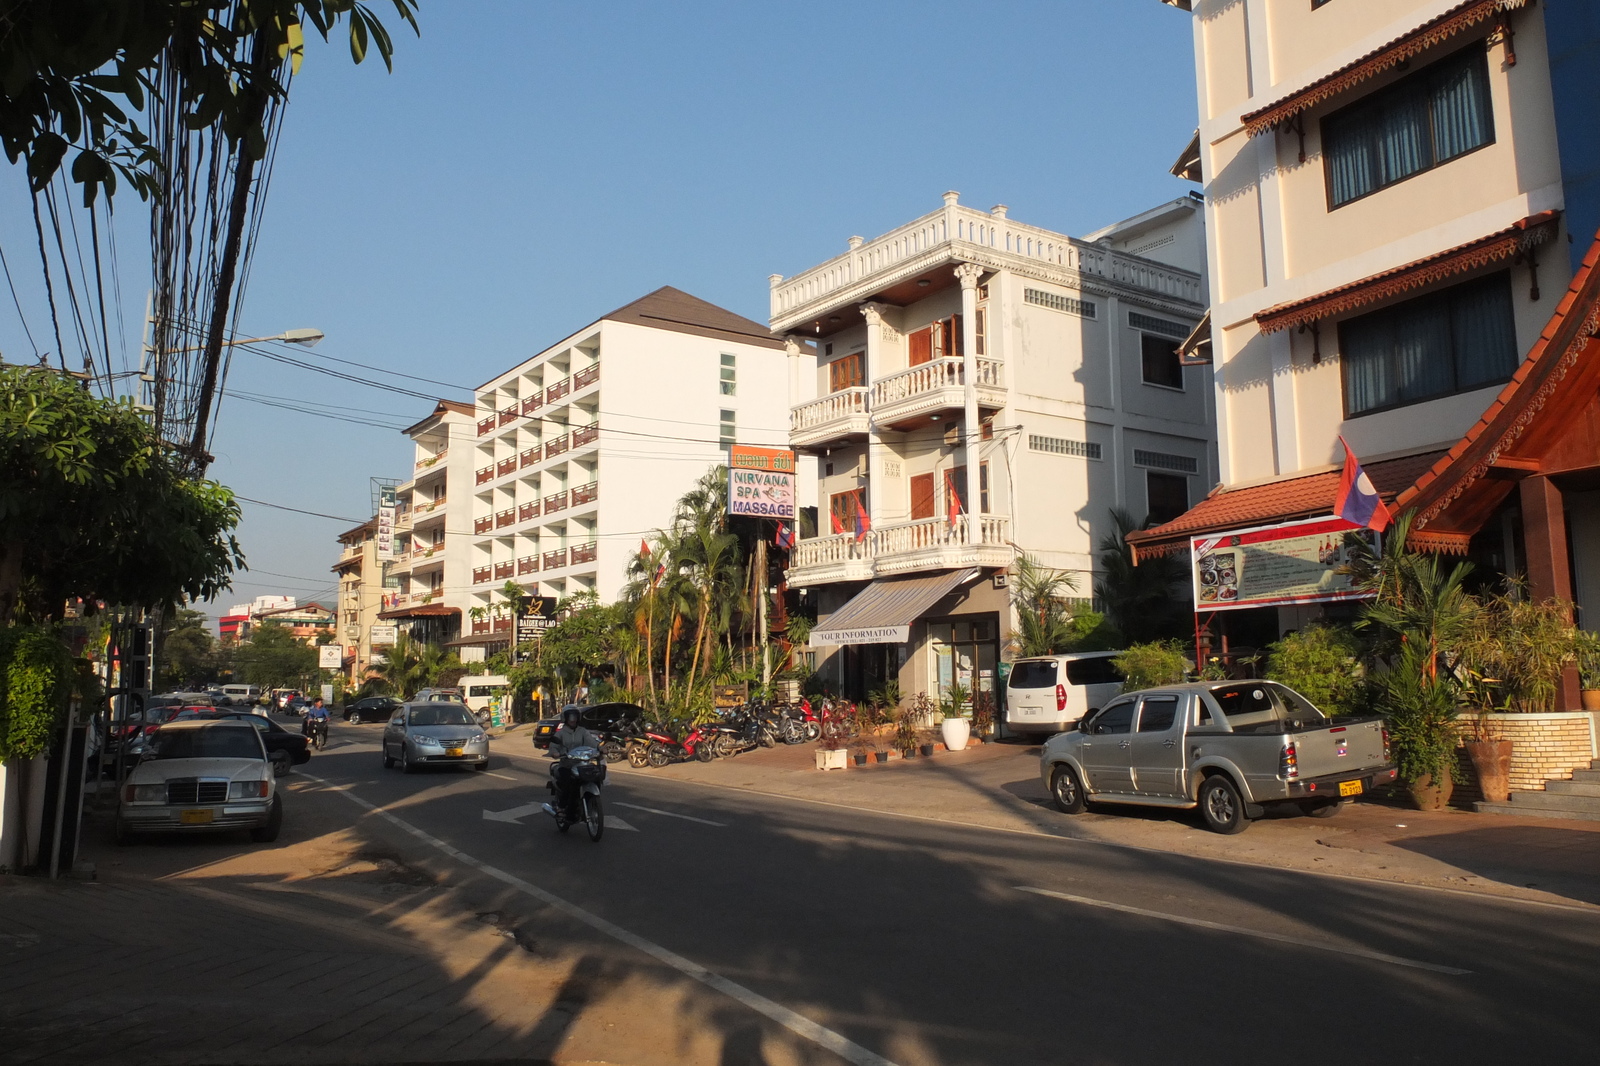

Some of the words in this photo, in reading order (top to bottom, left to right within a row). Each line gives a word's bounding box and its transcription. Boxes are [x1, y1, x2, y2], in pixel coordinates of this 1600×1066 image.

[734, 472, 790, 487] NIRVANA
[737, 486, 760, 499] SPA
[733, 501, 794, 516] MASSAGE
[820, 632, 841, 641] TOUR
[843, 628, 898, 639] INFORMATION
